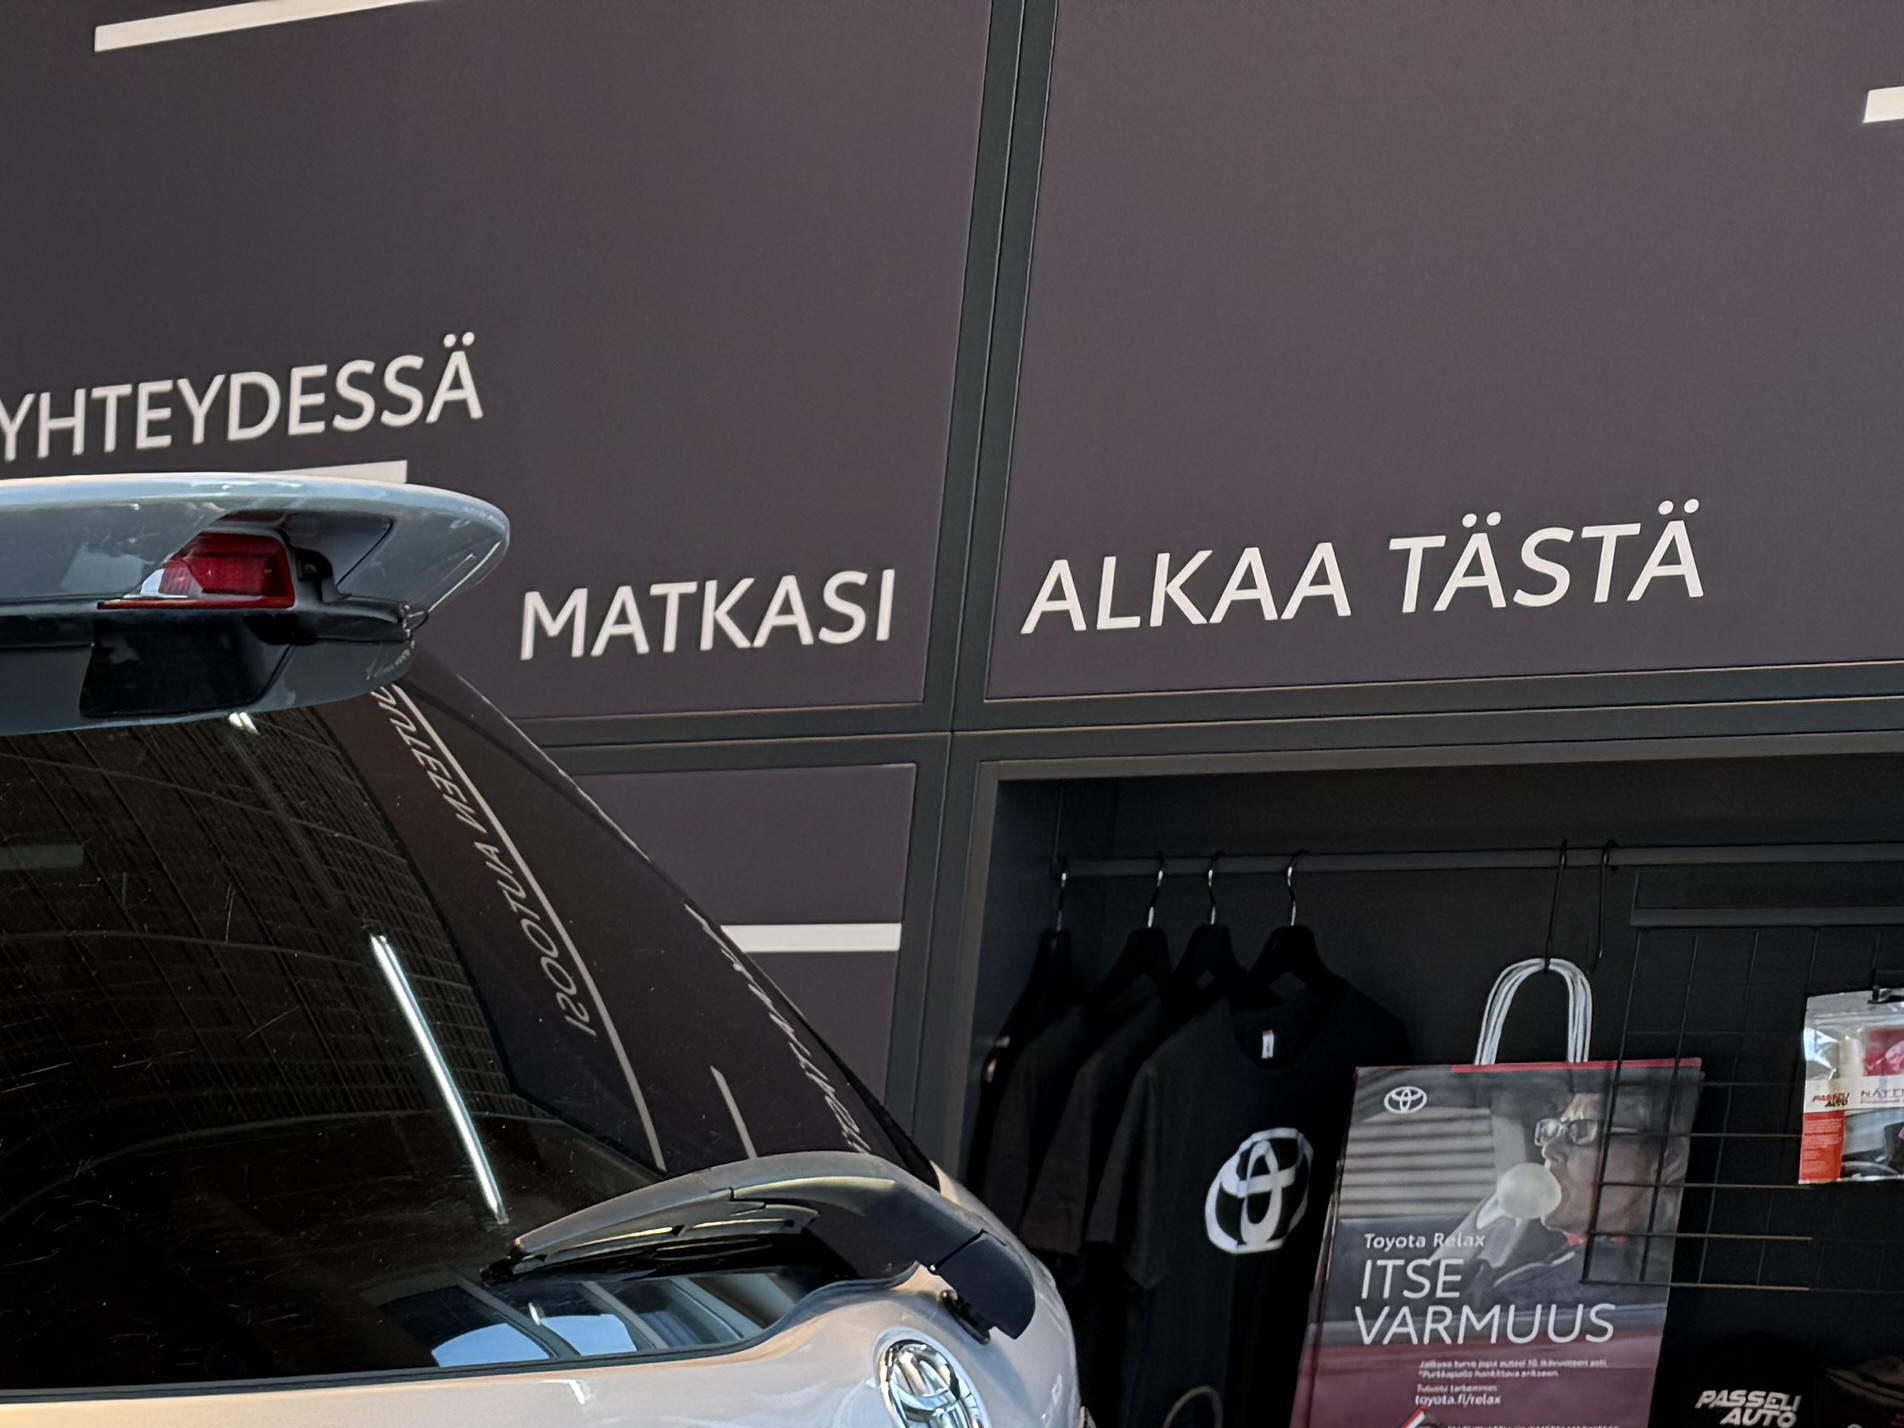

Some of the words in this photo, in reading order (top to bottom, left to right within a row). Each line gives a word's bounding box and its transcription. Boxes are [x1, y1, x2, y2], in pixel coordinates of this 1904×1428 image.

[520, 569, 896, 662] MATKASI
[1021, 539, 1353, 635] ALKAA
[1387, 496, 1706, 614] TÄSTÄ
[1364, 1232, 1427, 1253] Toyota
[1433, 1232, 1486, 1248] Relax
[1361, 1258, 1464, 1299] ITSE
[1354, 1303, 1617, 1345] VARMUUS
[1415, 1394, 1501, 1408] toyota.fi/relax
[1694, 1389, 1803, 1412] PASSELI
